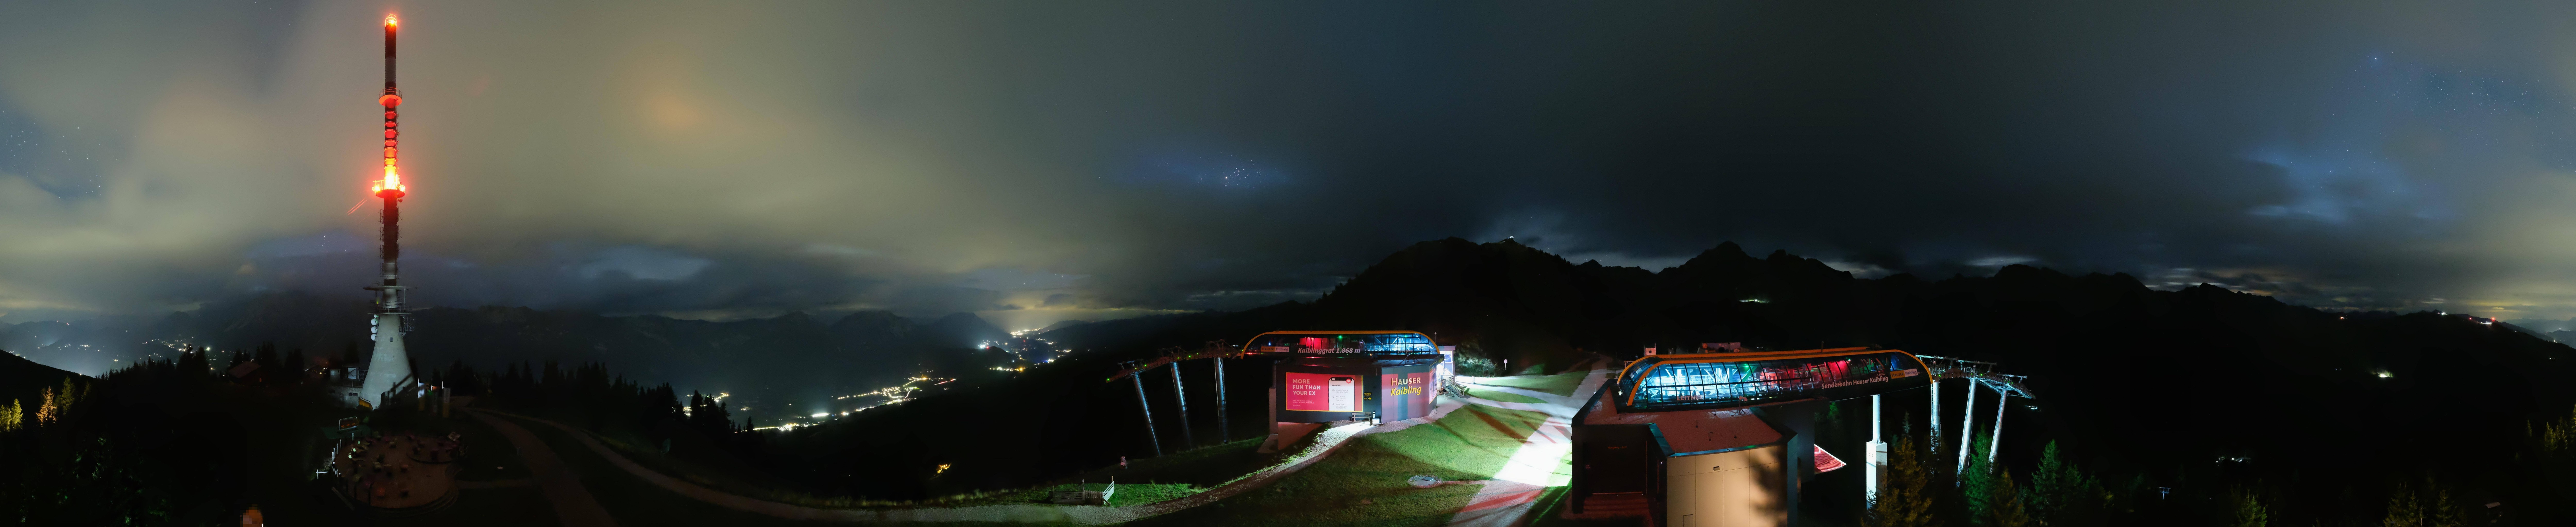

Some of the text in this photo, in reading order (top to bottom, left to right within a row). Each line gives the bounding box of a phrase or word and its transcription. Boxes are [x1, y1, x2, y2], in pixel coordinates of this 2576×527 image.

[1391, 377, 1421, 386] HAUSER
[1822, 380, 1852, 389] Senderbahn
[1391, 386, 1421, 396] Kaibling
